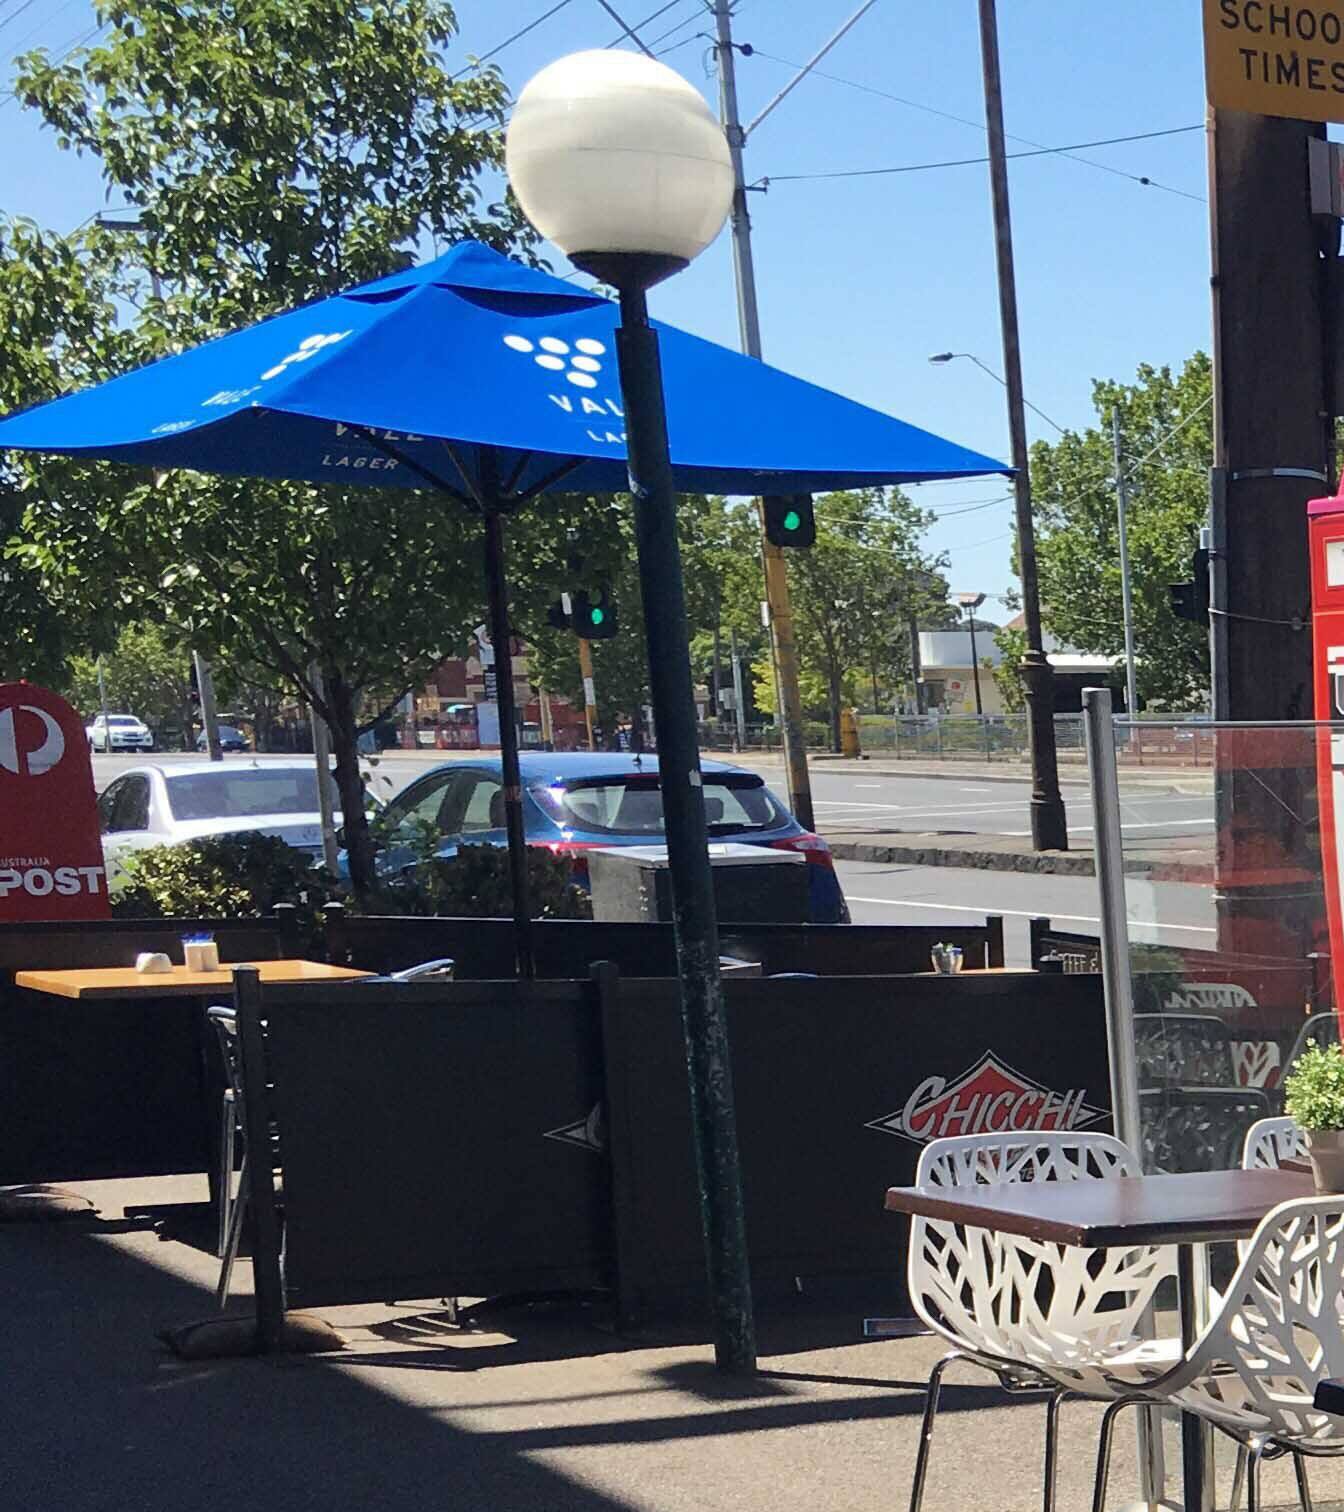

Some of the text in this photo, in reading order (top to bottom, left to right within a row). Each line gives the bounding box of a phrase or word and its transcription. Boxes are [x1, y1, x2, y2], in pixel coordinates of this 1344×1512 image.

[321, 454, 400, 470] LAGER
[0, 857, 51, 868] USTRALIA
[0, 866, 105, 897] POST
[902, 1076, 1088, 1139] CHICCHI
